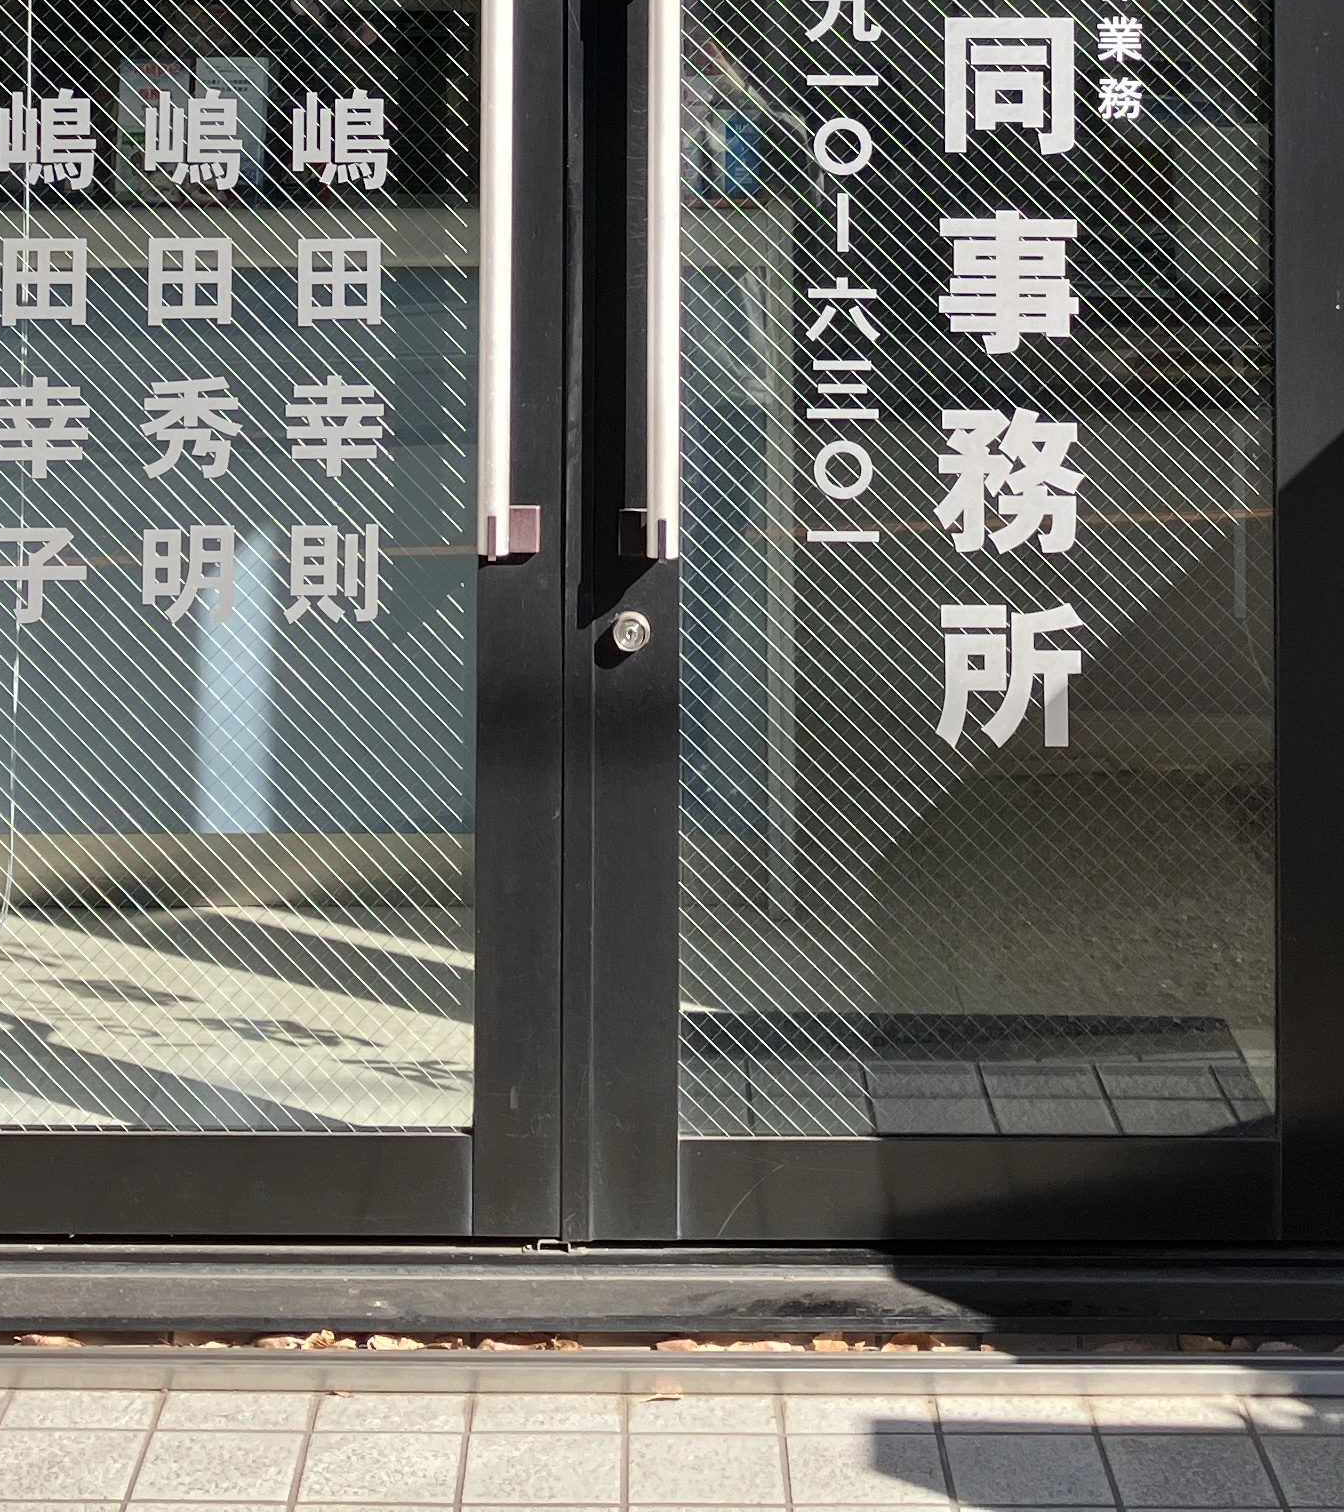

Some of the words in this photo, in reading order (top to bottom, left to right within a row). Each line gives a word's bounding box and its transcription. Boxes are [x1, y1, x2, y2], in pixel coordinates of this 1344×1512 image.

[140, 89, 244, 625] 嶋田秀明
[284, 89, 391, 625] 嶋田幸則
